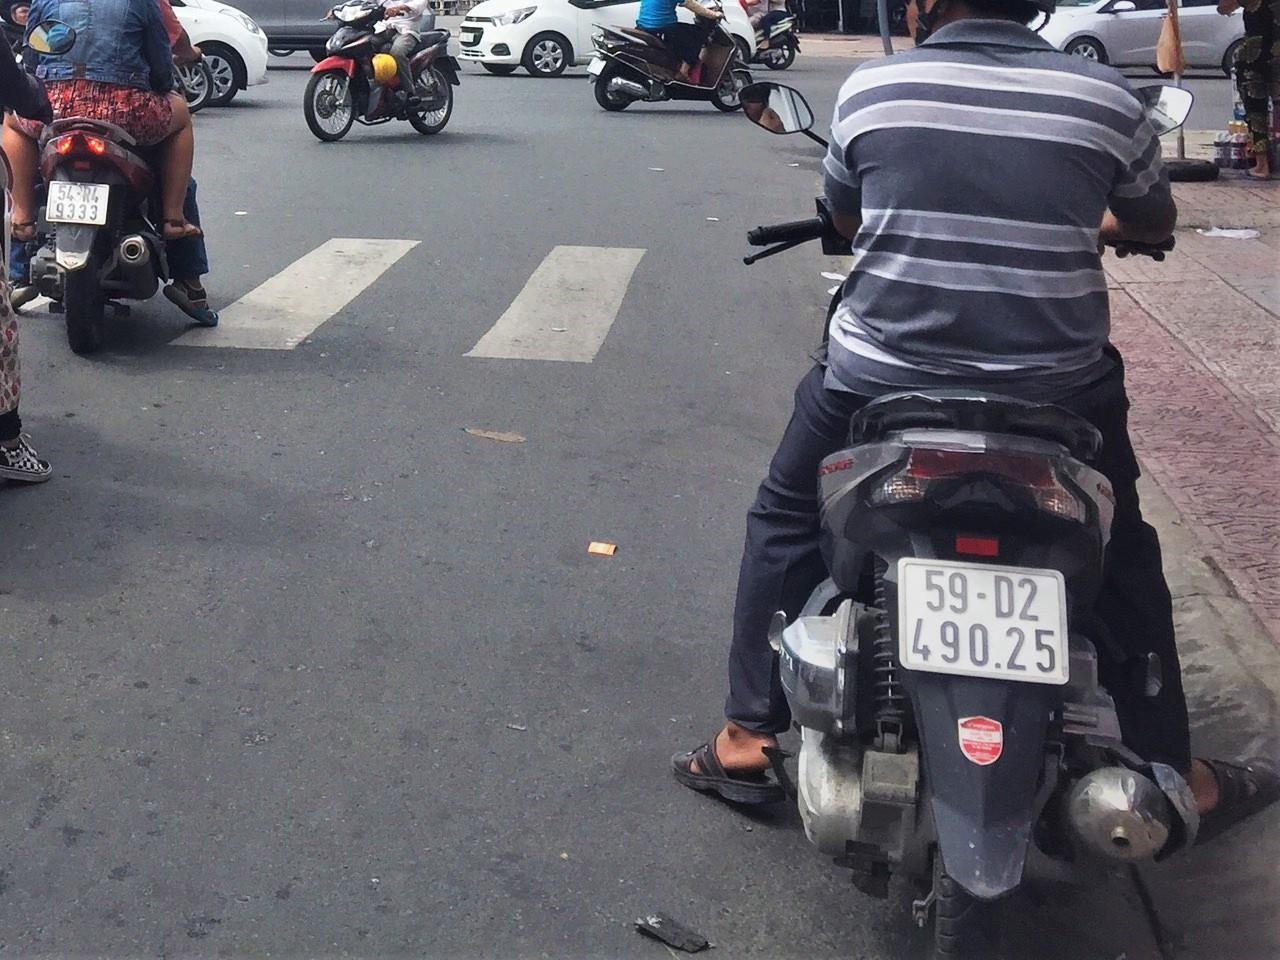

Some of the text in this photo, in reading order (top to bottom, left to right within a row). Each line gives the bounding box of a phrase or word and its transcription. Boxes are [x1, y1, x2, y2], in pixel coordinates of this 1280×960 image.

[55, 202, 98, 221] 9333
[924, 569, 1039, 622] 59-D2
[911, 618, 1056, 673] 490.25
